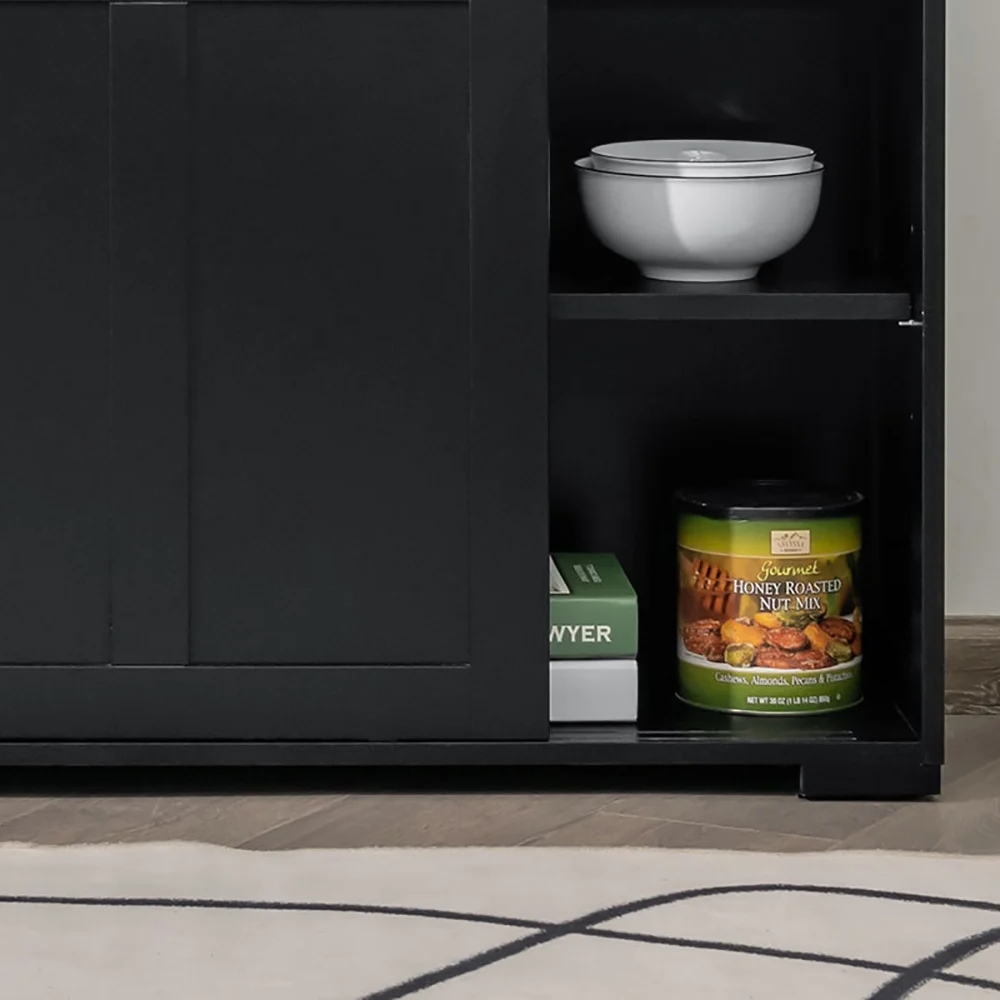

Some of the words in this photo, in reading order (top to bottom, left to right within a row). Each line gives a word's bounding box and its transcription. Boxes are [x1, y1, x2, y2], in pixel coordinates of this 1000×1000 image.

[757, 560, 820, 581] Gourmet
[733, 579, 781, 595] HONEY
[786, 579, 842, 595] ROASTED
[760, 596, 791, 611] NUT
[796, 597, 821, 611] MIX
